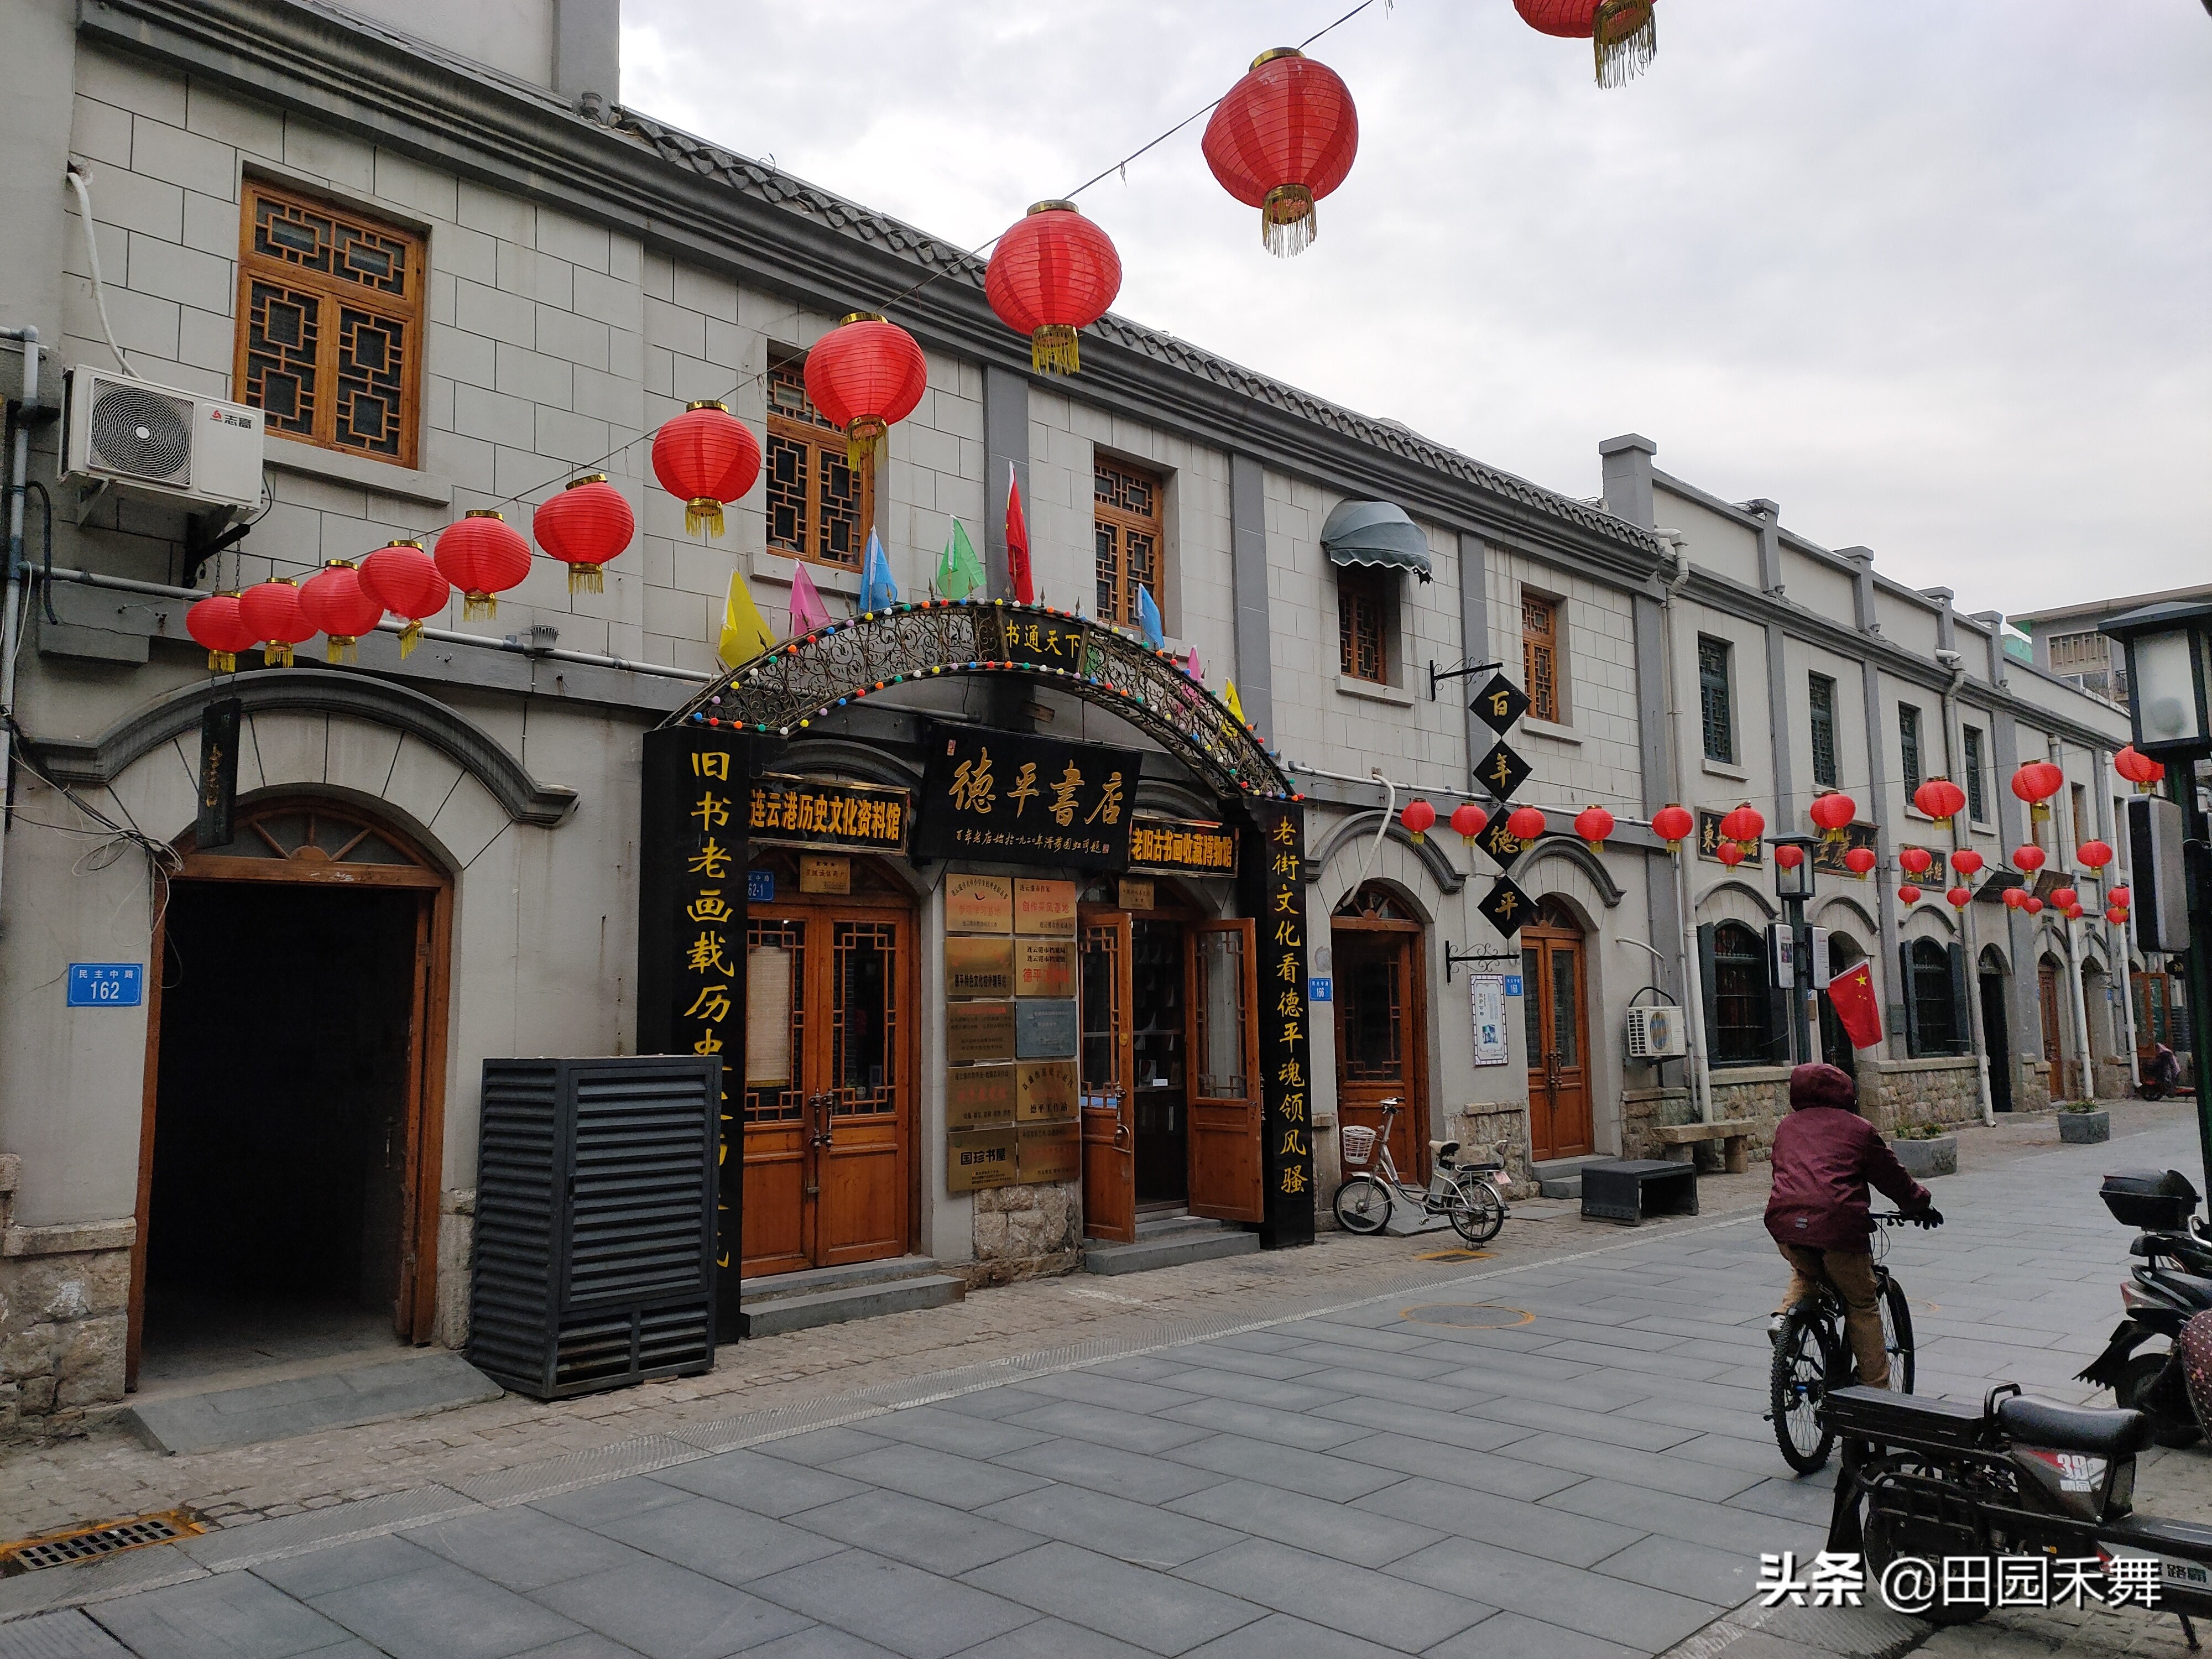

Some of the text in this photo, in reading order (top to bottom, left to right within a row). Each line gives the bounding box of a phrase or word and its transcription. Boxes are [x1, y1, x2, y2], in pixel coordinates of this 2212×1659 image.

[224, 414, 252, 429] 志高
[1005, 619, 1081, 659] 书通天下
[749, 788, 901, 841] 连云港历史文化资料馆
[1131, 827, 1233, 868] 老旧古书画收藏博物馆
[748, 882, 764, 896] 62-1
[1022, 901, 1069, 913] 创作采风基地
[79, 969, 134, 979] 民主中路
[90, 981, 119, 1000] 162
[1271, 815, 1308, 1193] 老街文化看德平魂领风骚
[961, 1147, 1005, 1165] 国珍书屋
